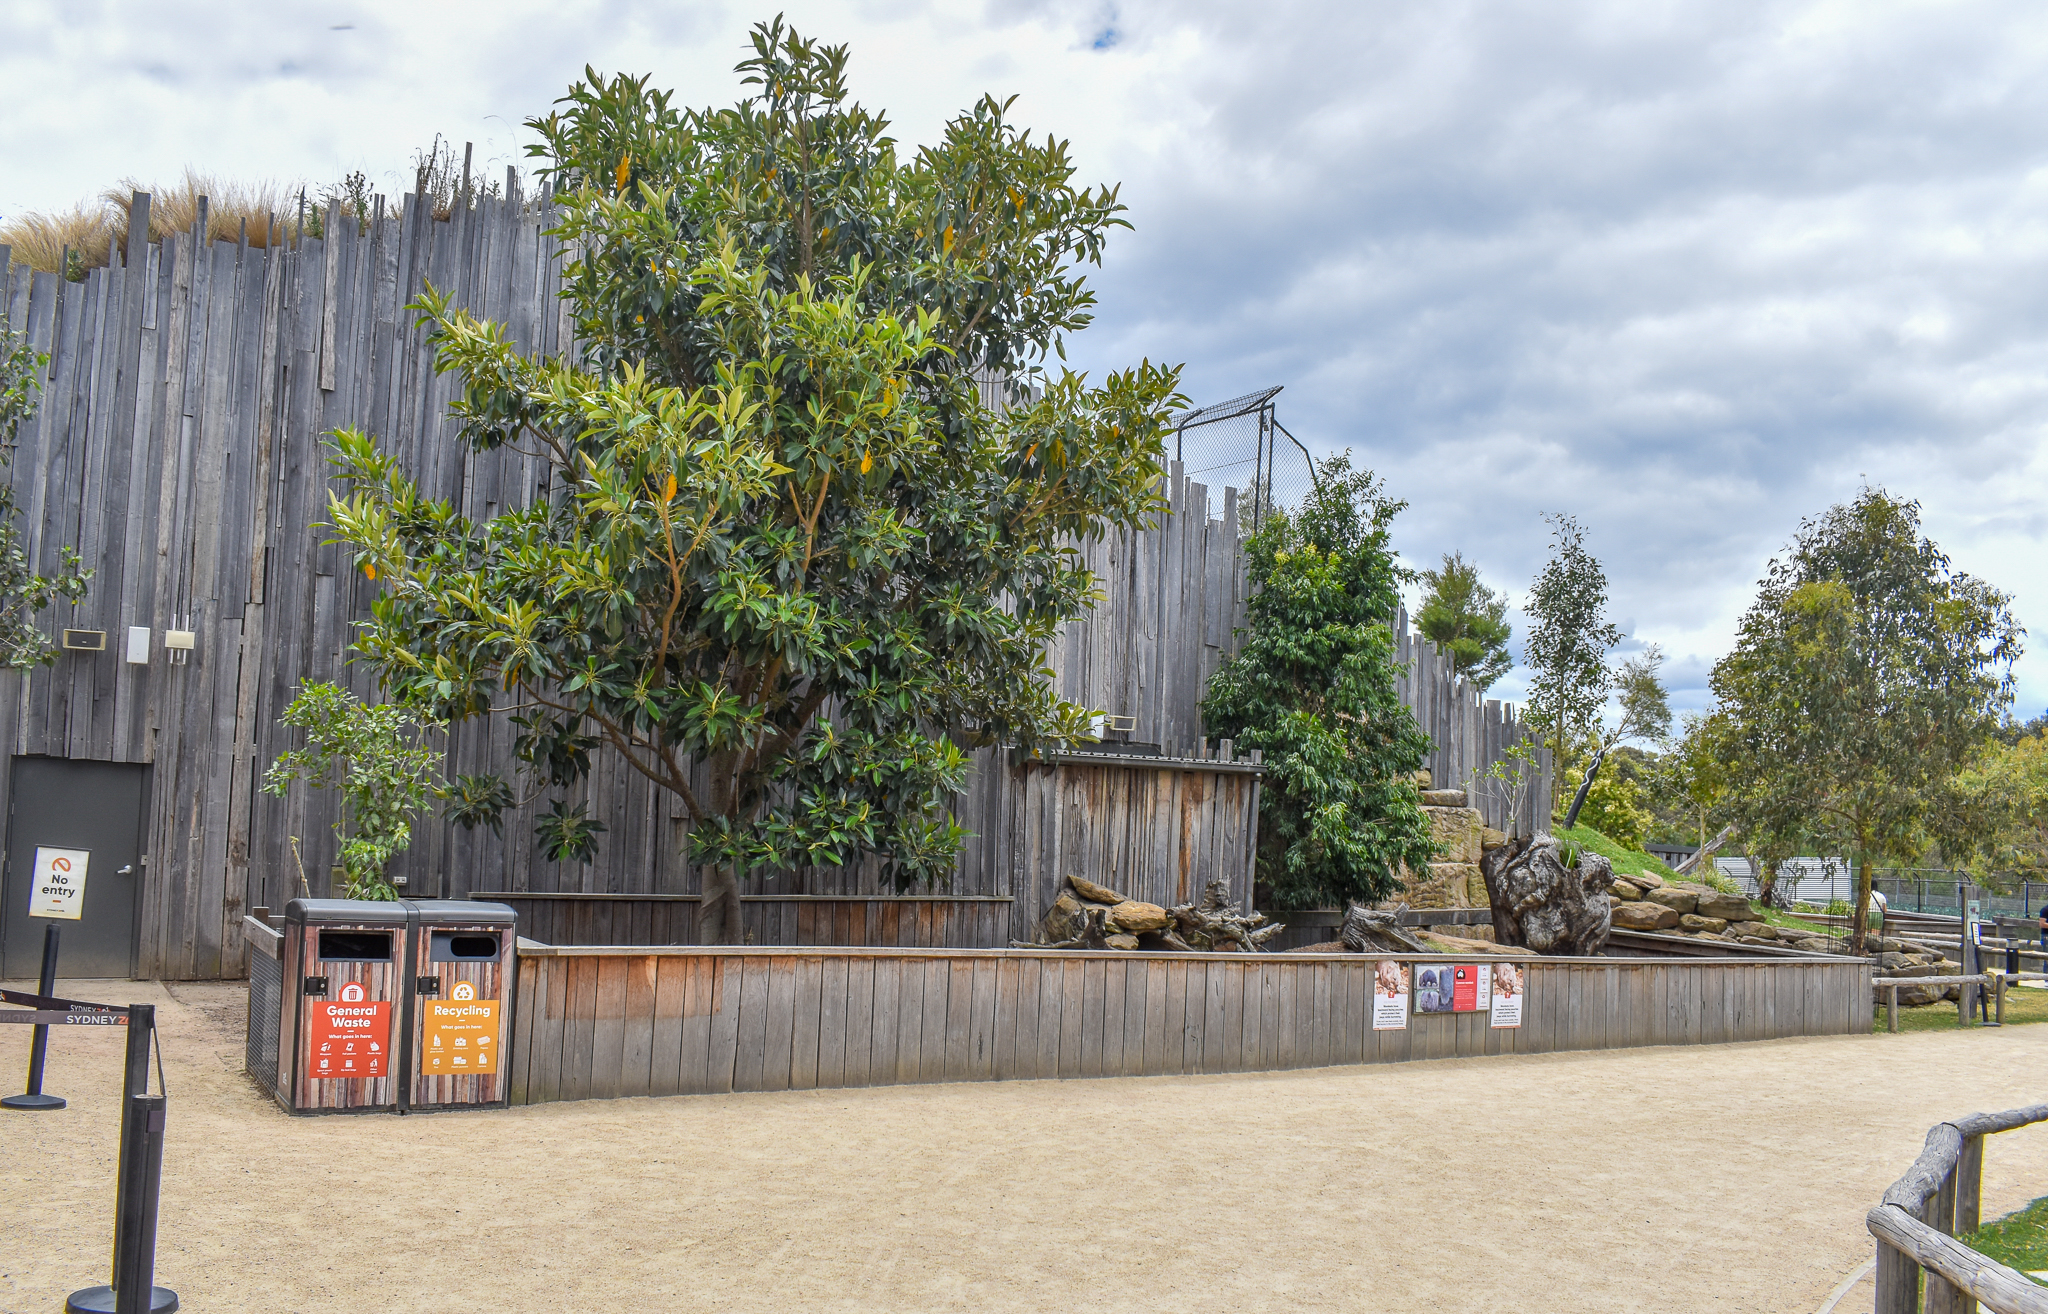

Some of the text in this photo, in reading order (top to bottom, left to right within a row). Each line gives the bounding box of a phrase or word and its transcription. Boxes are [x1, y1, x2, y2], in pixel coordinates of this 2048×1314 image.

[51, 874, 68, 885] No
[42, 886, 75, 898] entry
[326, 1004, 377, 1016] General
[434, 1005, 491, 1018] Recycling
[66, 1015, 117, 1025] SYDNEY
[331, 1017, 371, 1028] Waste
